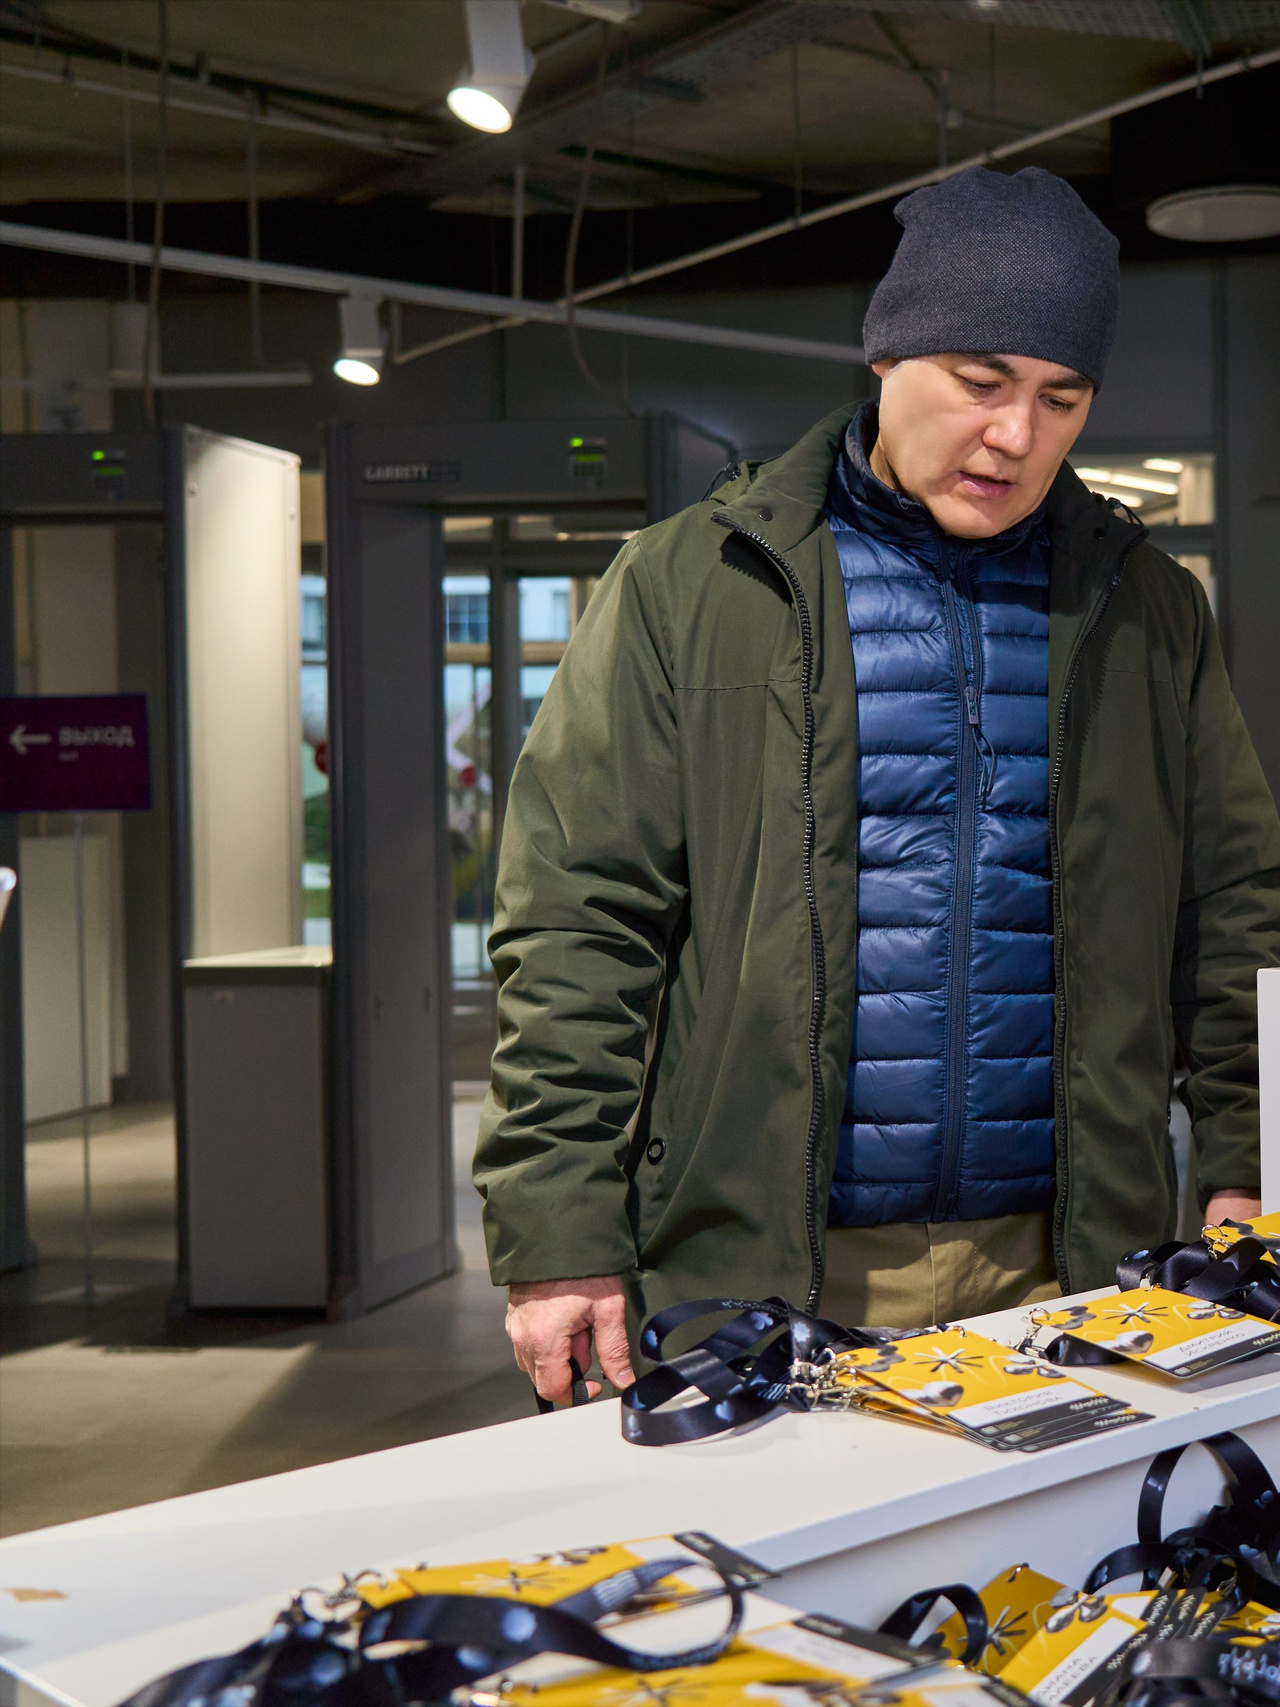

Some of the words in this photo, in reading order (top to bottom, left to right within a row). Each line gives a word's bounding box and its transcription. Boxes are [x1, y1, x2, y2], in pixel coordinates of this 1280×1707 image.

[59, 725, 136, 748] ВЫХОД
[1179, 1329, 1233, 1352] ДМИТРИЙ
[1184, 1332, 1246, 1357] ИСКРЕНКО
[983, 1390, 1051, 1411] ВИКТОРИЯ
[993, 1396, 1063, 1416] ТИХОНОВА
